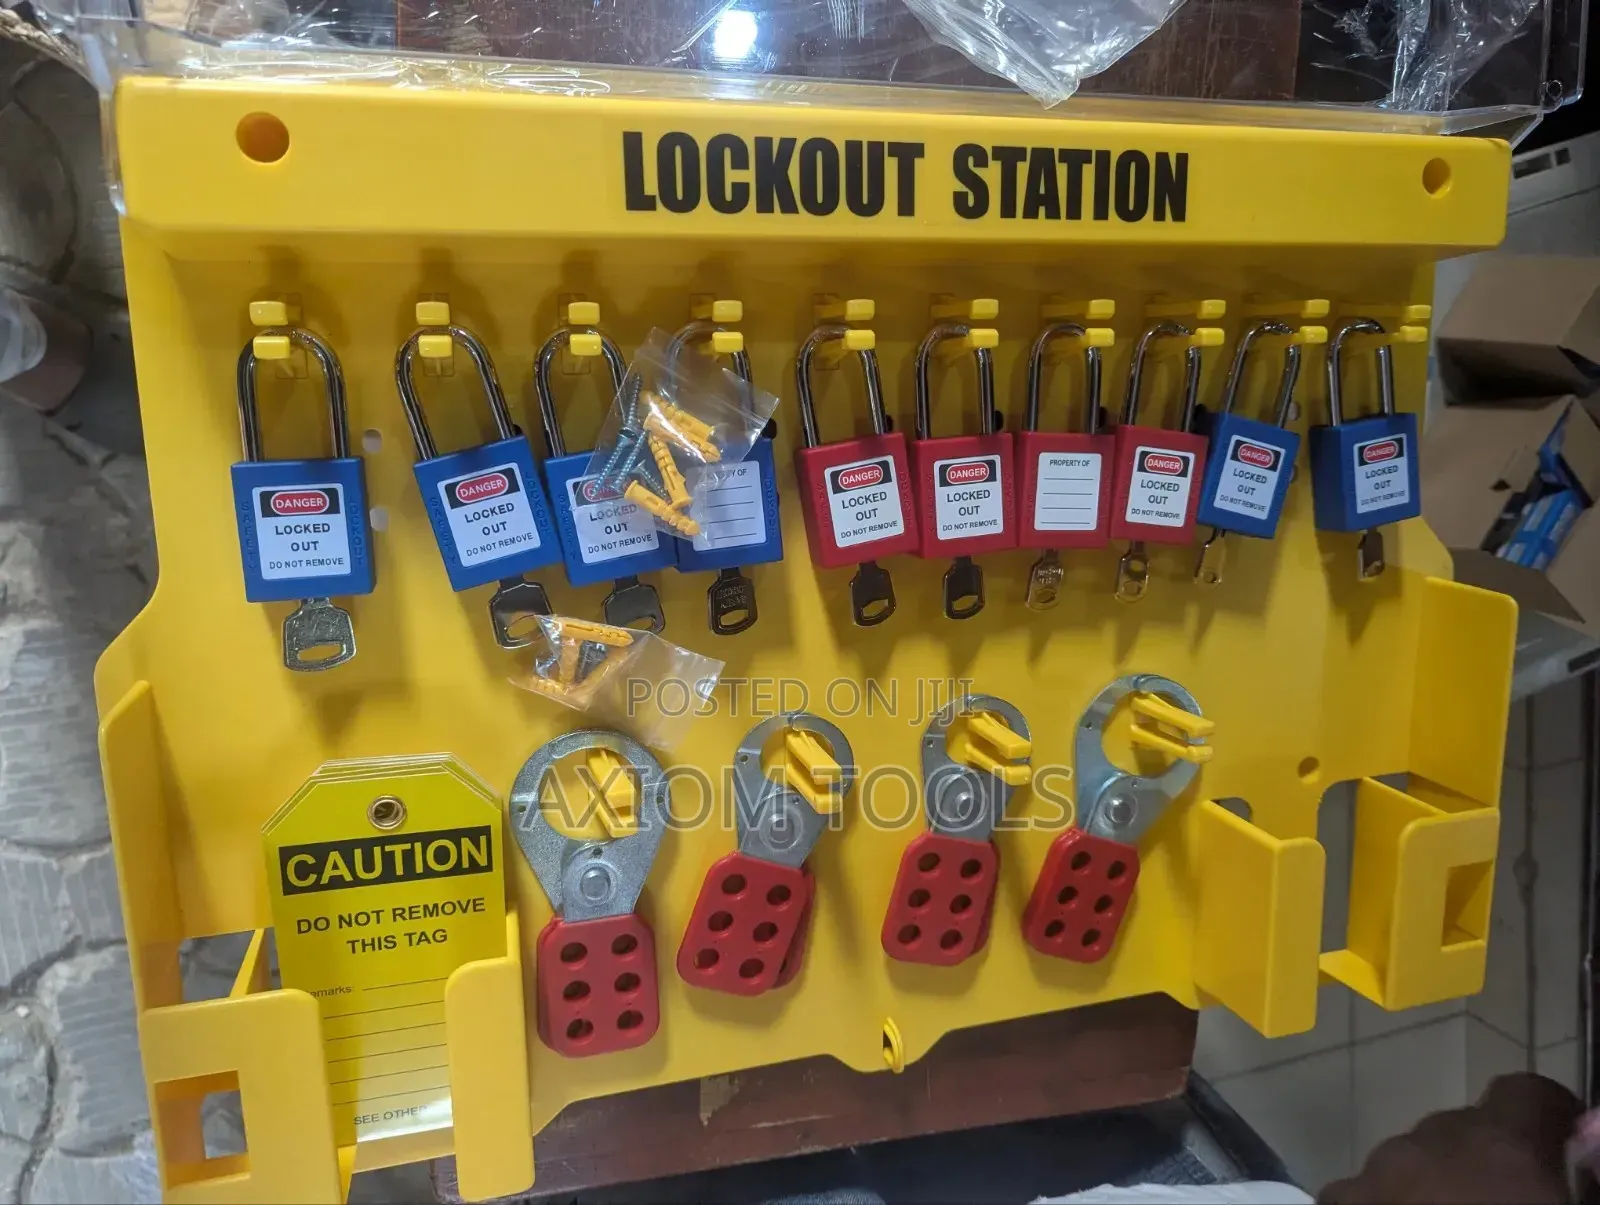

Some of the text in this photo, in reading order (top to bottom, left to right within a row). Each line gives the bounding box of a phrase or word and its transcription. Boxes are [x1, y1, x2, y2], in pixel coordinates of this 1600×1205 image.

[623, 130, 1190, 223] LOCKOUT STATION
[1241, 449, 1270, 462] DANGER
[1049, 459, 1091, 467] PROPERTY OF
[1148, 459, 1180, 469] DANGER
[737, 468, 748, 477] OF
[842, 470, 880, 485] DANGER
[950, 468, 986, 479] DANGER
[1233, 468, 1267, 483] LOCKED
[1365, 465, 1398, 479] LOCKED
[459, 479, 504, 497] DANGER
[1140, 480, 1180, 492] LOCKED
[1237, 484, 1257, 495] OUT
[1373, 480, 1392, 490] OUT
[275, 497, 324, 509] DANGER
[841, 491, 888, 509] LOCKED
[946, 490, 991, 503] LOCKED
[1148, 495, 1169, 505] OUT
[464, 502, 515, 524] LOCKED
[588, 503, 637, 522] LOCKED
[856, 508, 878, 521] OUT
[958, 505, 981, 516] OUT
[1155, 511, 1181, 519] REMOVE
[275, 523, 331, 535] LOCKED
[482, 521, 508, 536] OUT
[604, 523, 628, 535] OUT
[853, 527, 867, 536] NOT
[868, 520, 898, 533] REMOVE
[942, 519, 998, 532] DO NOT REMOVE
[290, 541, 320, 551] OUT
[466, 532, 533, 557] DO NOT REMOVE
[588, 533, 652, 554] DO NOT REMOVE
[269, 557, 344, 569] DO NOT REMOVE
[286, 835, 488, 887] CAUTION
[297, 898, 486, 934] DO NOT REMOVE
[347, 929, 448, 954] THIS TAG
[353, 1112, 379, 1125] SEE
